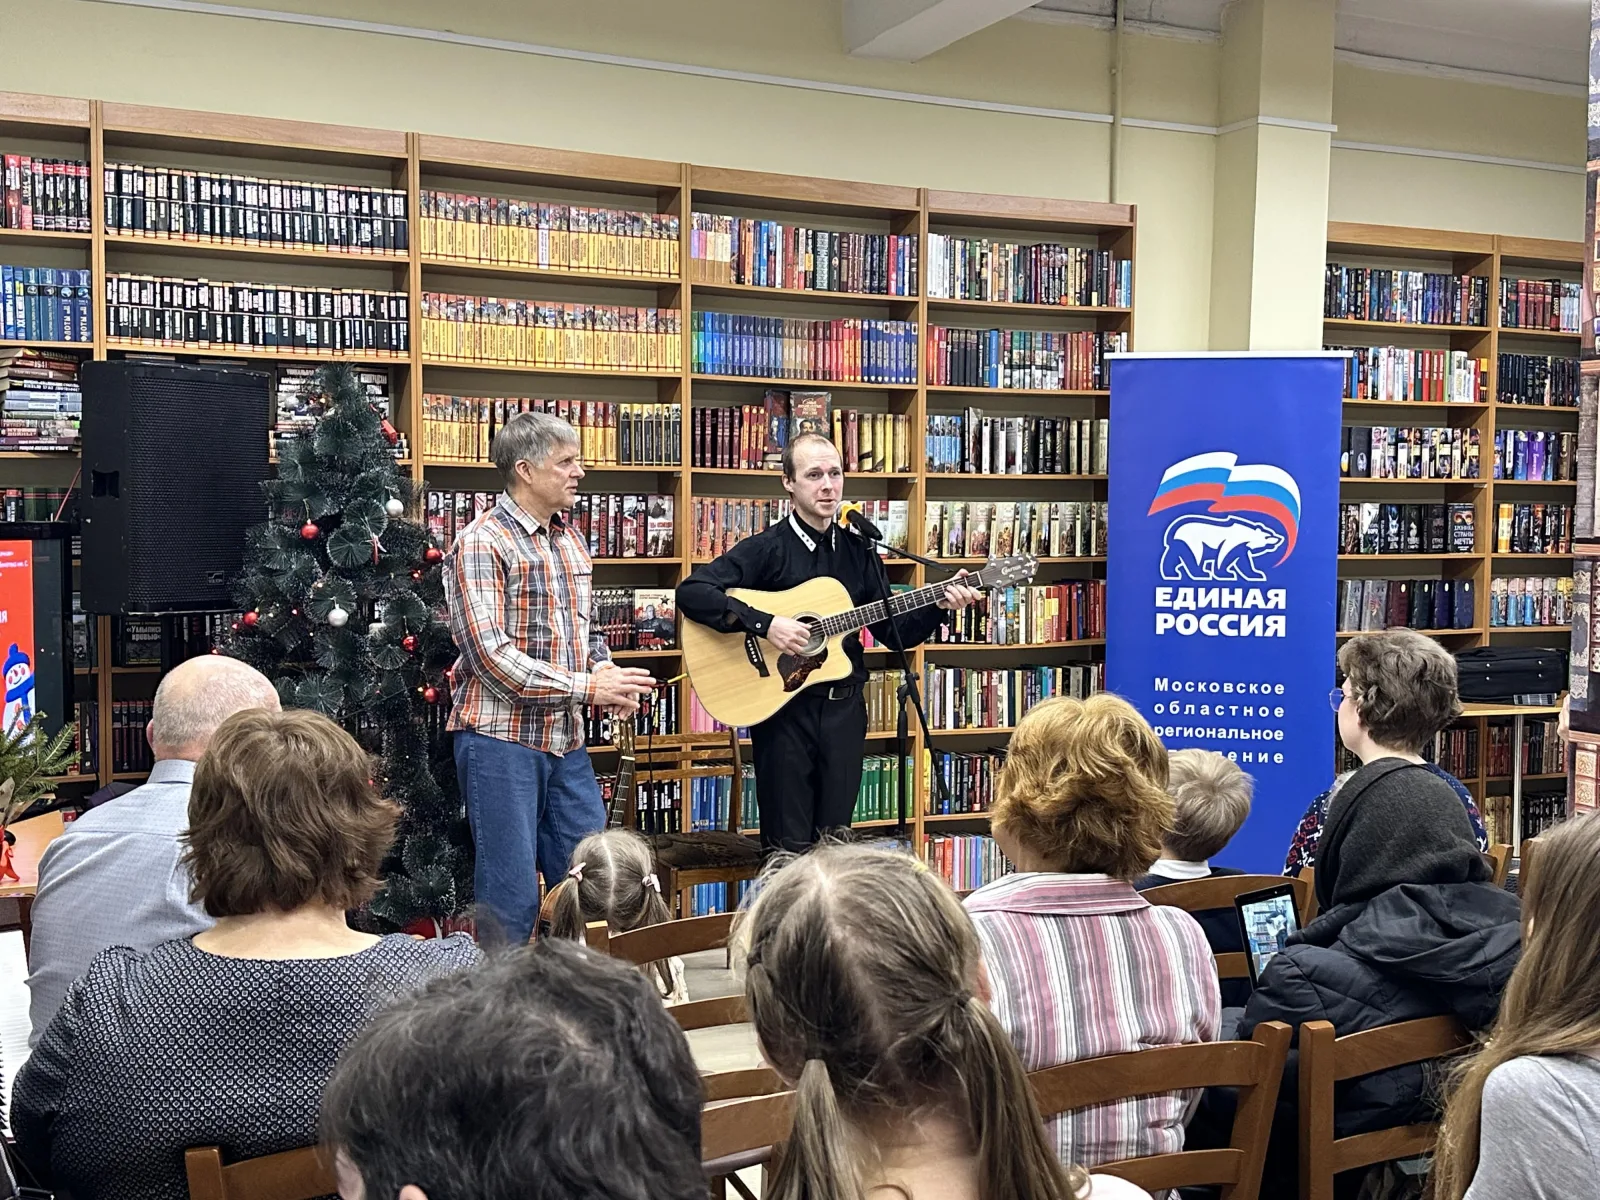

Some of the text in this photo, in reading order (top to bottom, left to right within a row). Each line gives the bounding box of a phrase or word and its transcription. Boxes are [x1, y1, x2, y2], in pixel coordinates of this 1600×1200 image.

[1155, 587, 1286, 610] ЕДИНАЯ
[1156, 614, 1286, 637] РОССИЯ
[1154, 677, 1285, 695] Московское
[1154, 701, 1285, 718] областное
[1154, 725, 1284, 741] региональное
